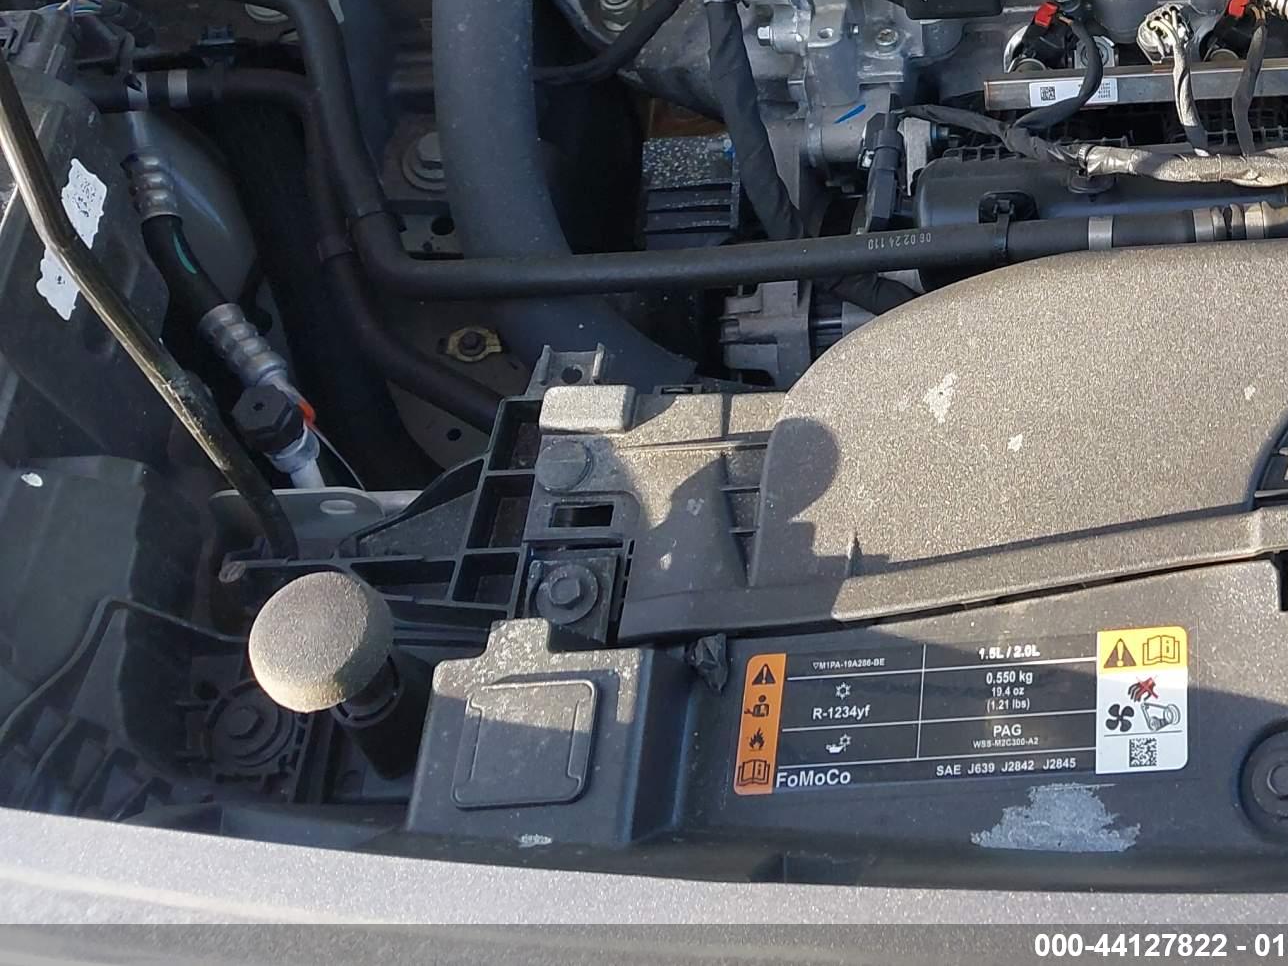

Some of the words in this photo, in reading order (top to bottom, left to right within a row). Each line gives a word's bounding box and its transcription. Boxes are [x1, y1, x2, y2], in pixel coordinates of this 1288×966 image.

[979, 646, 1004, 660] 1.5L
[1013, 643, 1041, 658] 2.0L
[986, 671, 1016, 684] 0.550
[1019, 670, 1033, 684] kg
[992, 686, 1010, 697] 19.4
[1013, 687, 1024, 696] oz
[812, 705, 871, 720] R-1234yf
[986, 699, 1009, 713] (1.21
[1012, 698, 1031, 710] lbs)
[993, 724, 1022, 738] PAG
[936, 764, 962, 777] SAE
[967, 763, 995, 775] J639
[1001, 760, 1035, 773] J2842
[1043, 758, 1077, 771] J2845
[776, 769, 851, 788] FoMoCo
